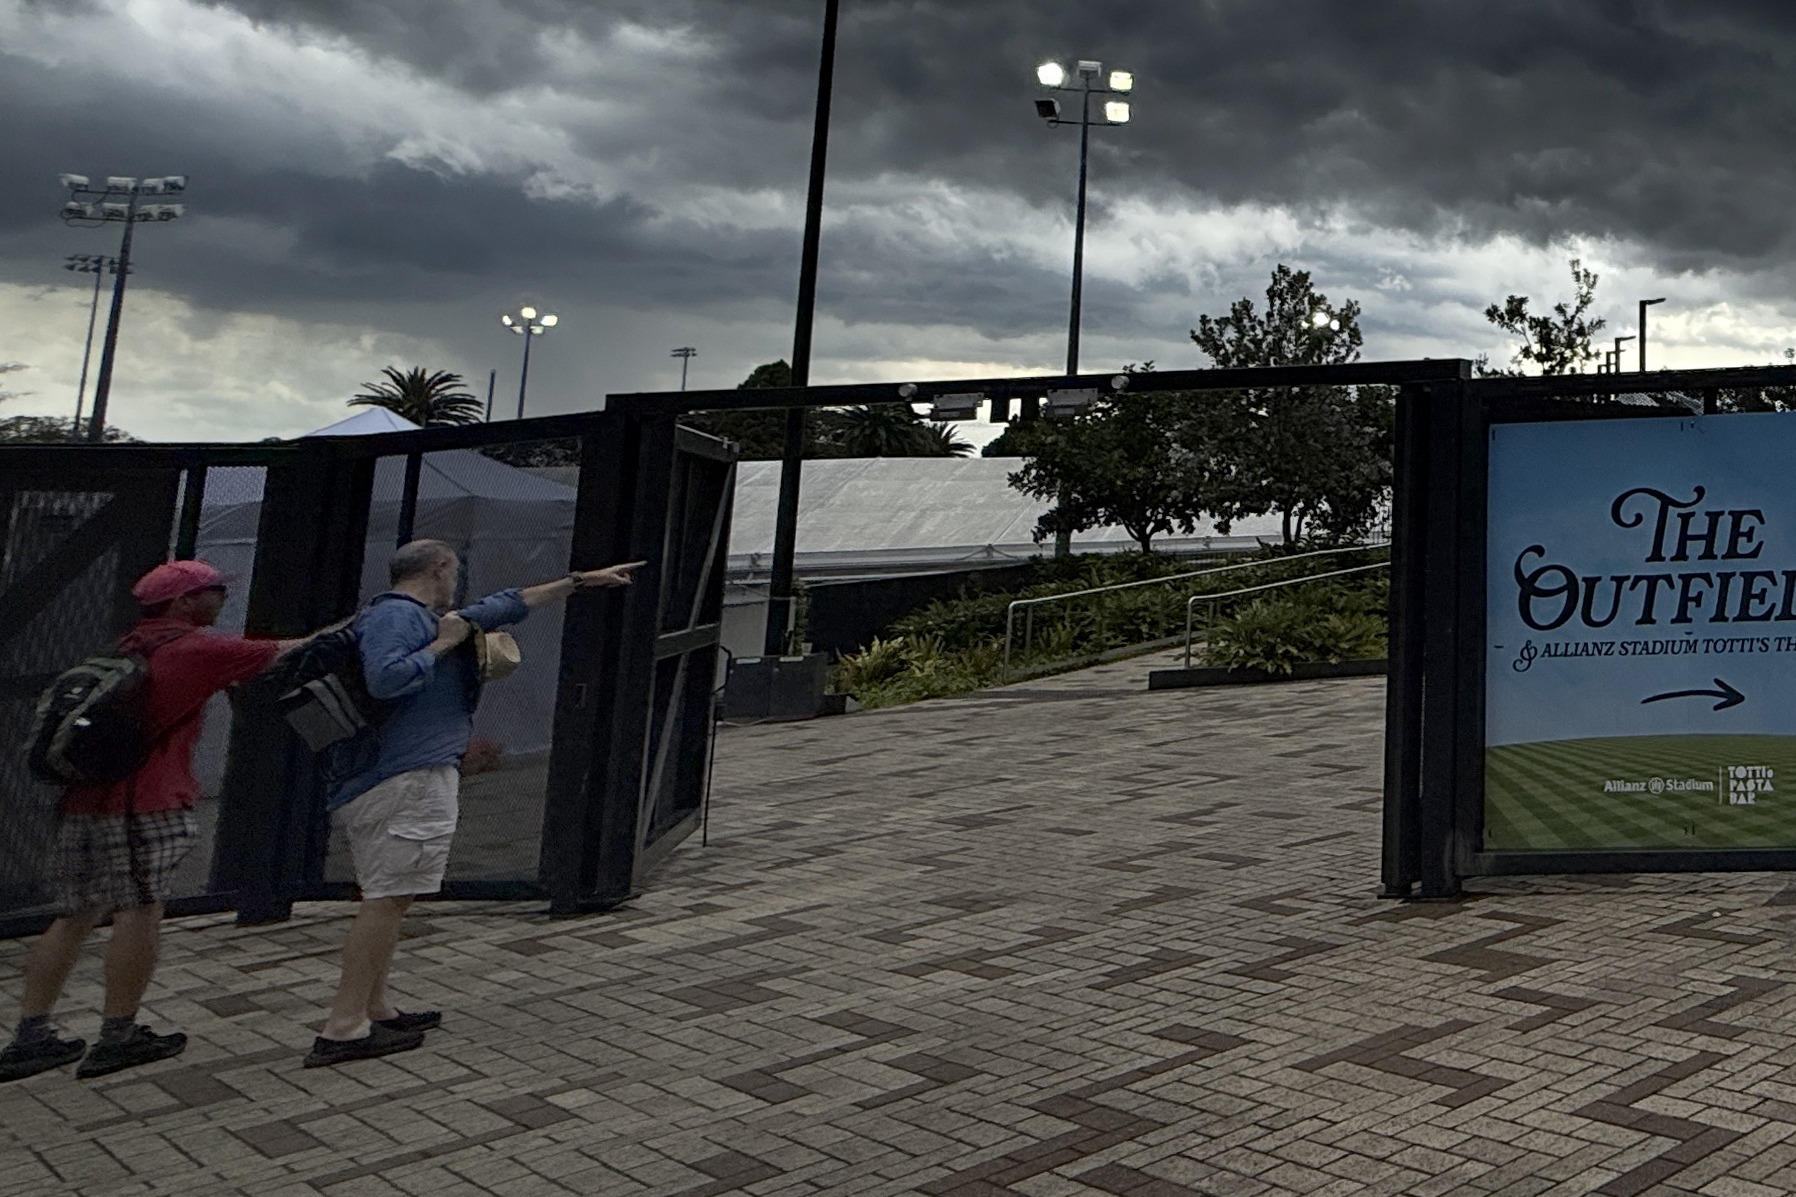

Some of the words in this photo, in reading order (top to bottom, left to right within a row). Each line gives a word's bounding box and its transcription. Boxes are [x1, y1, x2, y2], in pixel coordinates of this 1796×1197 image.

[1611, 486, 1765, 562] THE
[1512, 640, 1538, 672] &
[1540, 641, 1616, 657] ALLIANZ
[1618, 639, 1699, 656] STADIUM
[1702, 637, 1770, 653] TOTTI'S
[1604, 779, 1646, 792] Allianz
[1666, 778, 1714, 791] Stadium
[1729, 779, 1774, 791] PASTA
[1729, 792, 1756, 805] BAR
